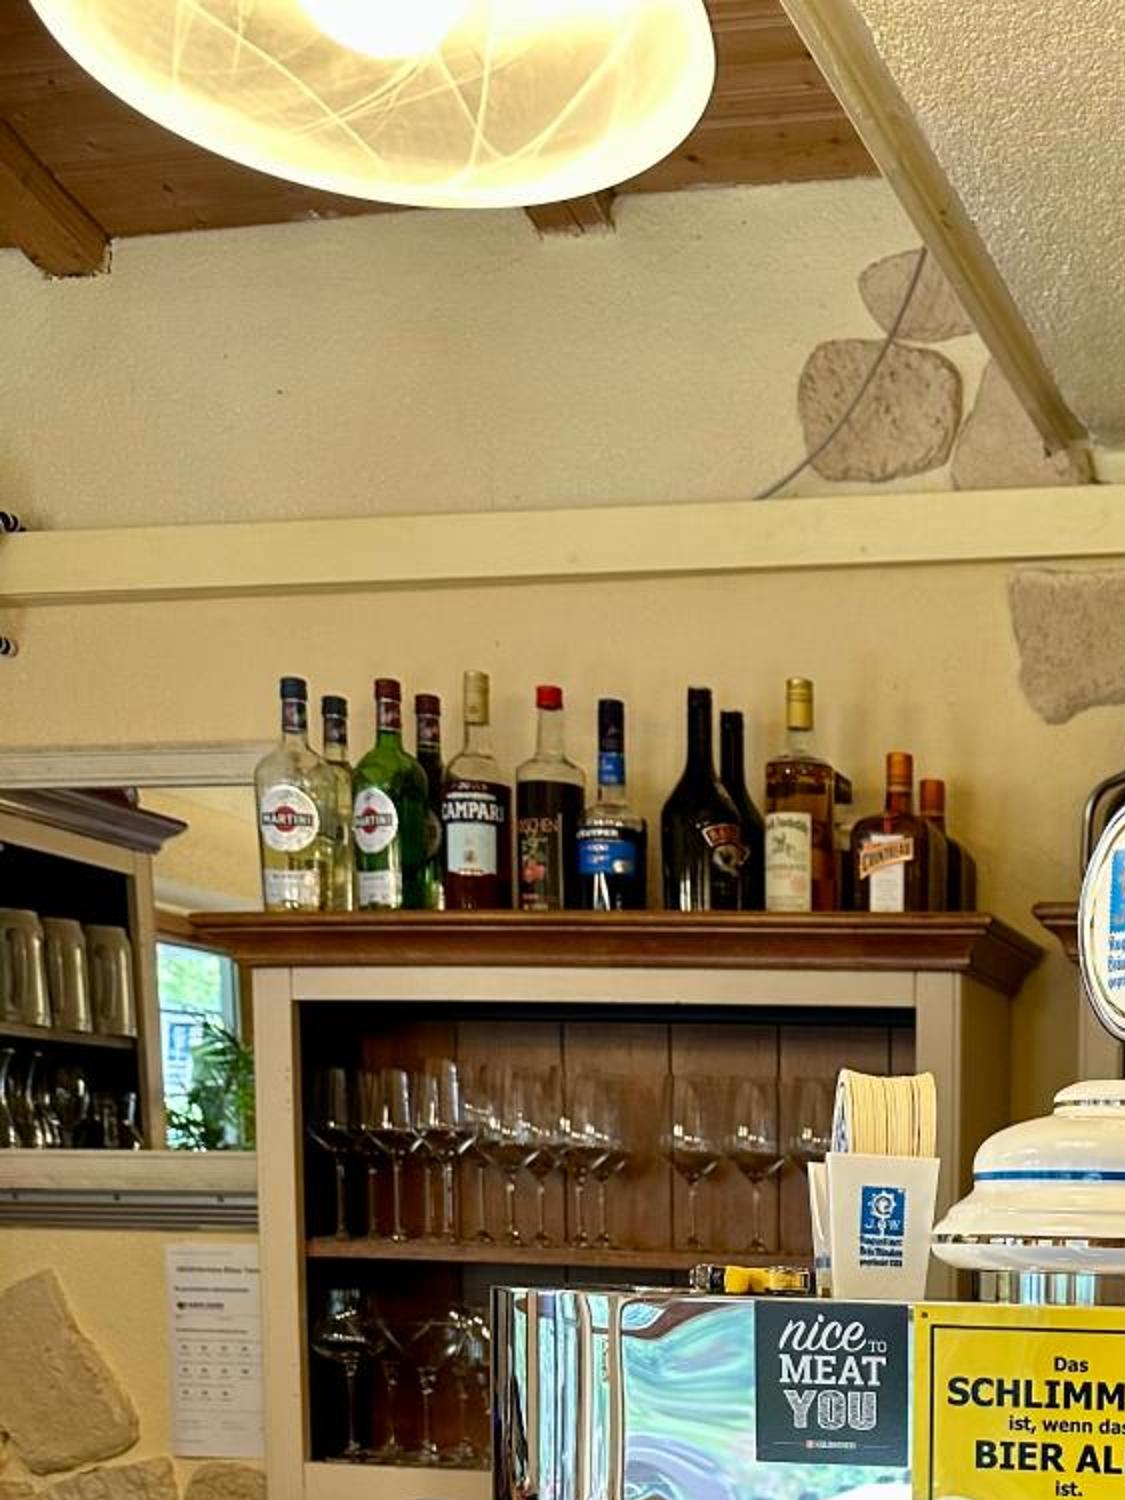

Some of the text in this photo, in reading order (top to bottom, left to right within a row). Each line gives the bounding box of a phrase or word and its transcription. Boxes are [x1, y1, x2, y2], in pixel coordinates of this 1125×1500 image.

[779, 1314, 887, 1353] nice TO
[779, 1354, 887, 1386] MEAT
[1054, 1357, 1089, 1373] Das
[783, 1389, 877, 1431] YOU
[1009, 1415, 1036, 1433] ist,
[1042, 1420, 1092, 1434] wenn
[975, 1440, 1064, 1472] BIER
[1055, 1481, 1083, 1497] ist.
